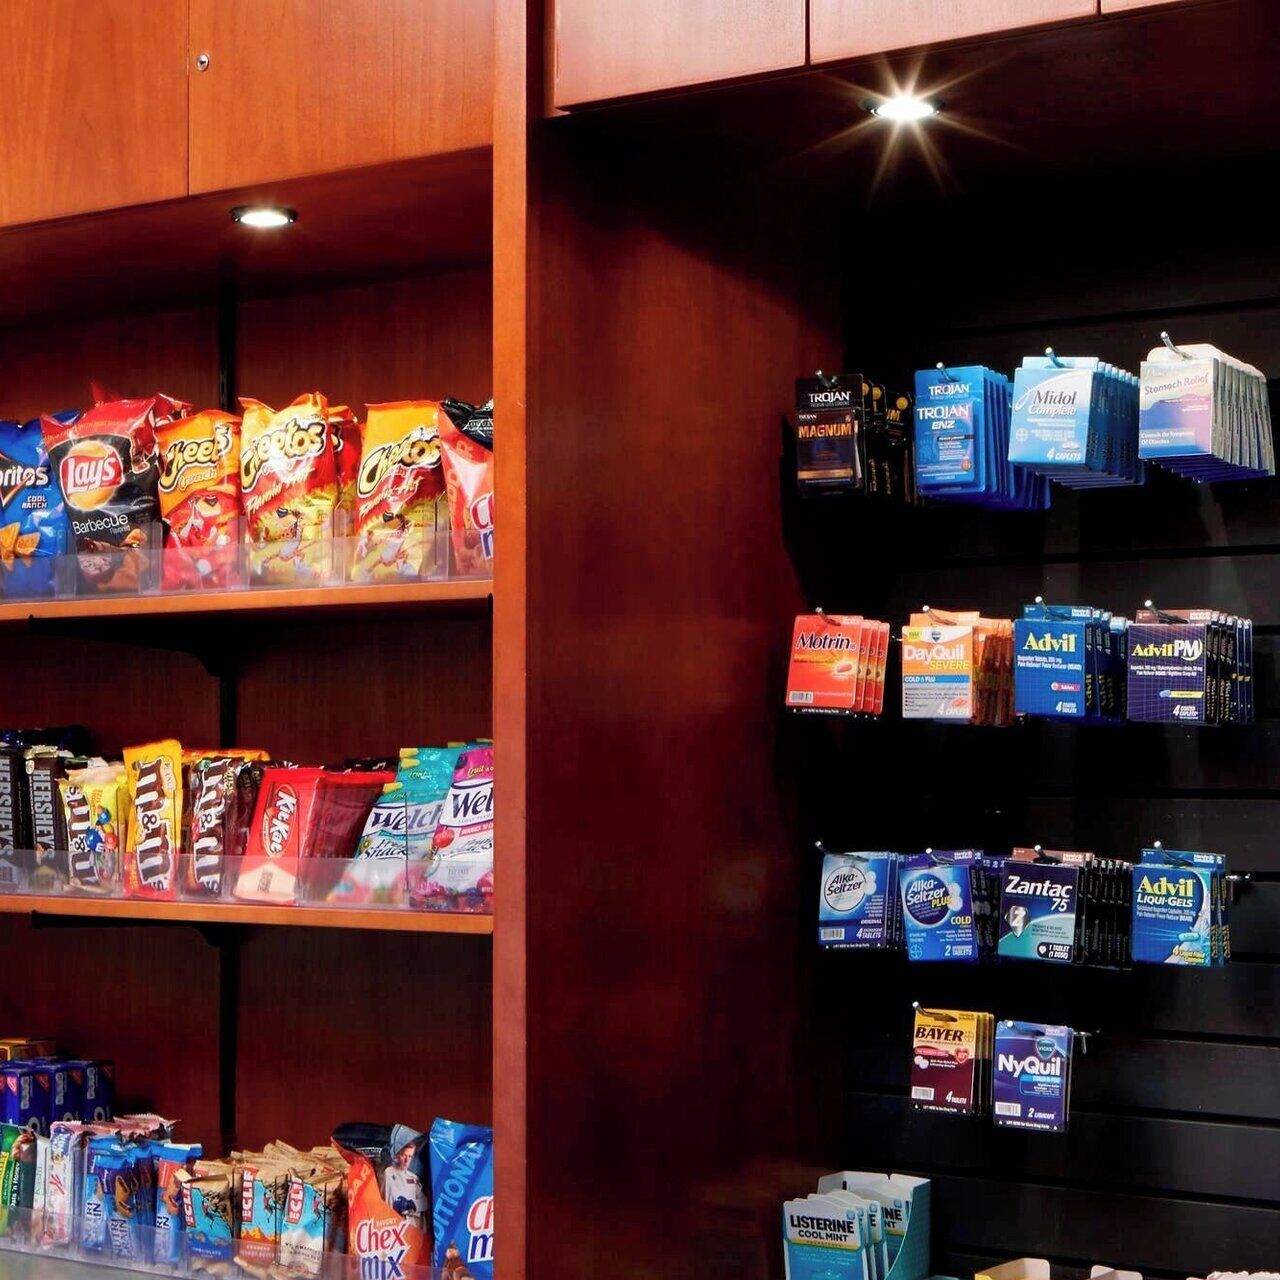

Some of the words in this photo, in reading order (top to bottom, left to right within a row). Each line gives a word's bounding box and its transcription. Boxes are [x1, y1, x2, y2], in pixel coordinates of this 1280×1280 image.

[928, 384, 970, 396] TROJAN
[1144, 378, 1183, 396] Stomach
[1183, 372, 1209, 386] Relief
[809, 391, 850, 403] TROJAN
[1033, 390, 1078, 405] Midol
[916, 405, 970, 420] TROJAN
[1028, 404, 1077, 417] Complete
[798, 423, 852, 438] MAGNUM
[931, 420, 956, 430] ENZ
[72, 513, 129, 535] Barbecue
[796, 632, 851, 650] Motrin
[1022, 632, 1076, 652] Advil
[903, 644, 965, 665] DayQuil
[1131, 643, 1173, 657] Advil
[930, 660, 969, 671] SEVERE
[1173, 704, 1181, 717] 4
[33, 769, 56, 859] HERSHEY'S
[831, 872, 858, 885] Alka-
[1136, 875, 1194, 897] Advil
[826, 880, 864, 896] Seltzer
[908, 880, 938, 894] Alka-
[1005, 875, 1073, 898] Zantac
[906, 886, 947, 906] Seltzer
[931, 896, 952, 908] PLUS
[1050, 898, 1071, 912] 75
[950, 915, 972, 926] COLD
[856, 927, 863, 939] 4
[915, 1026, 964, 1042] BAYER
[998, 1054, 1061, 1078] NyQuil
[946, 1091, 952, 1103] 4
[1028, 1107, 1034, 1118] 2
[790, 1214, 855, 1234] LISTERINE
[356, 1220, 407, 1254] Chex
[798, 1229, 825, 1240] COOL
[825, 1232, 848, 1242] MINT
